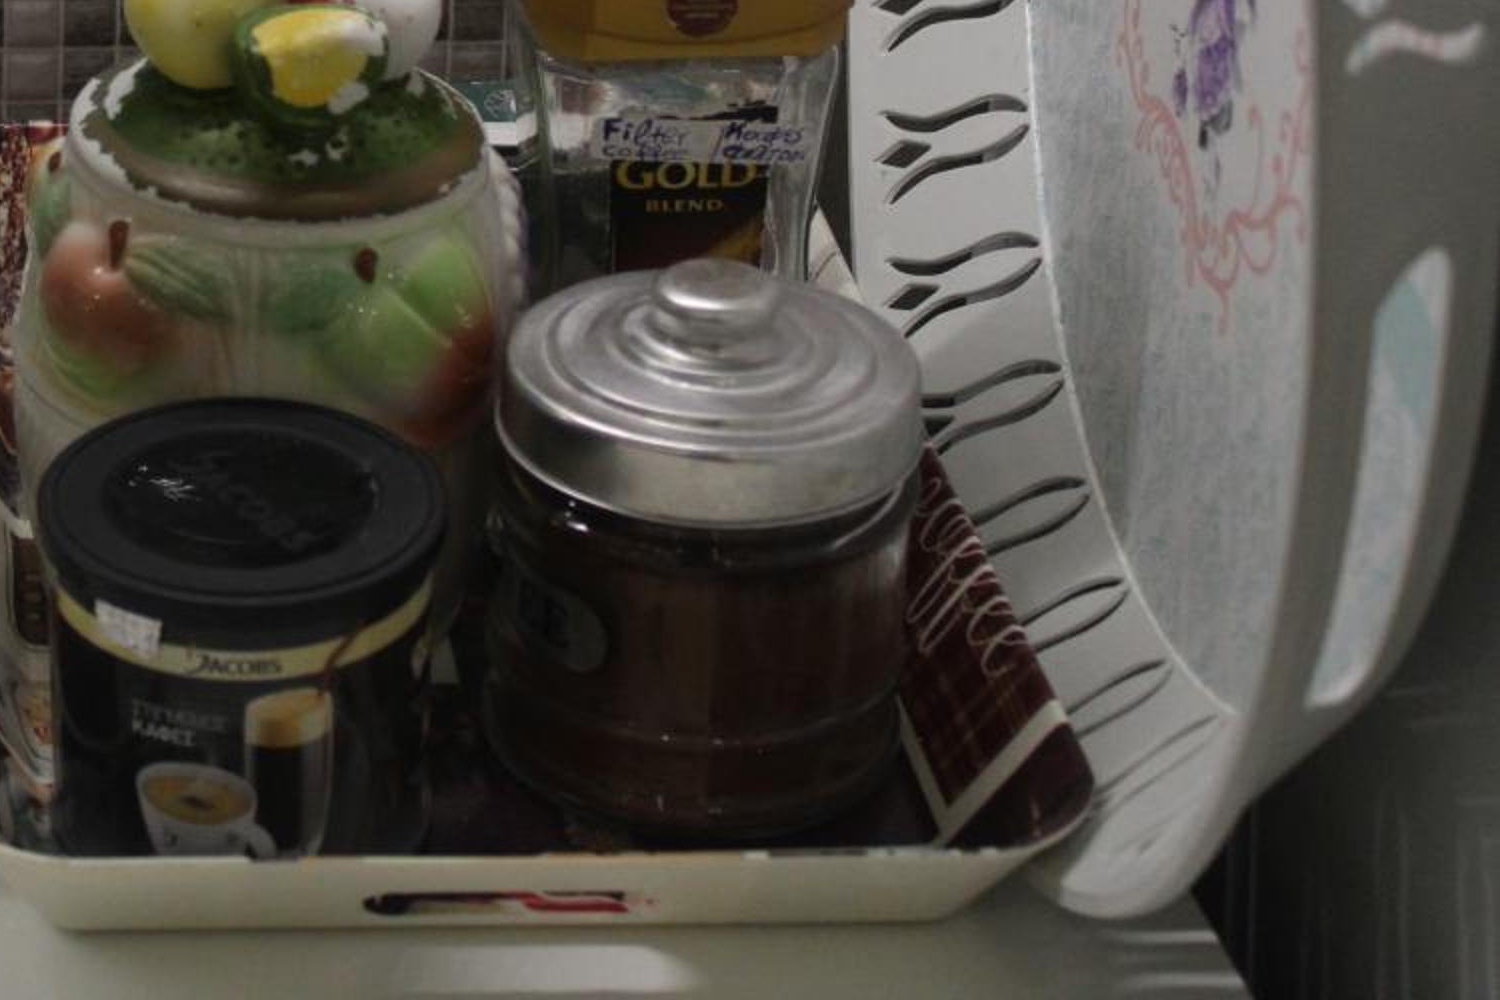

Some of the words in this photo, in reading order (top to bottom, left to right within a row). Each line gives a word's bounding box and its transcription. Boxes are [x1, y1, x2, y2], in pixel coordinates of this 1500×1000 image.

[602, 117, 689, 147] Filter
[615, 158, 758, 190] GOLD
[645, 199, 725, 214] BLEND
